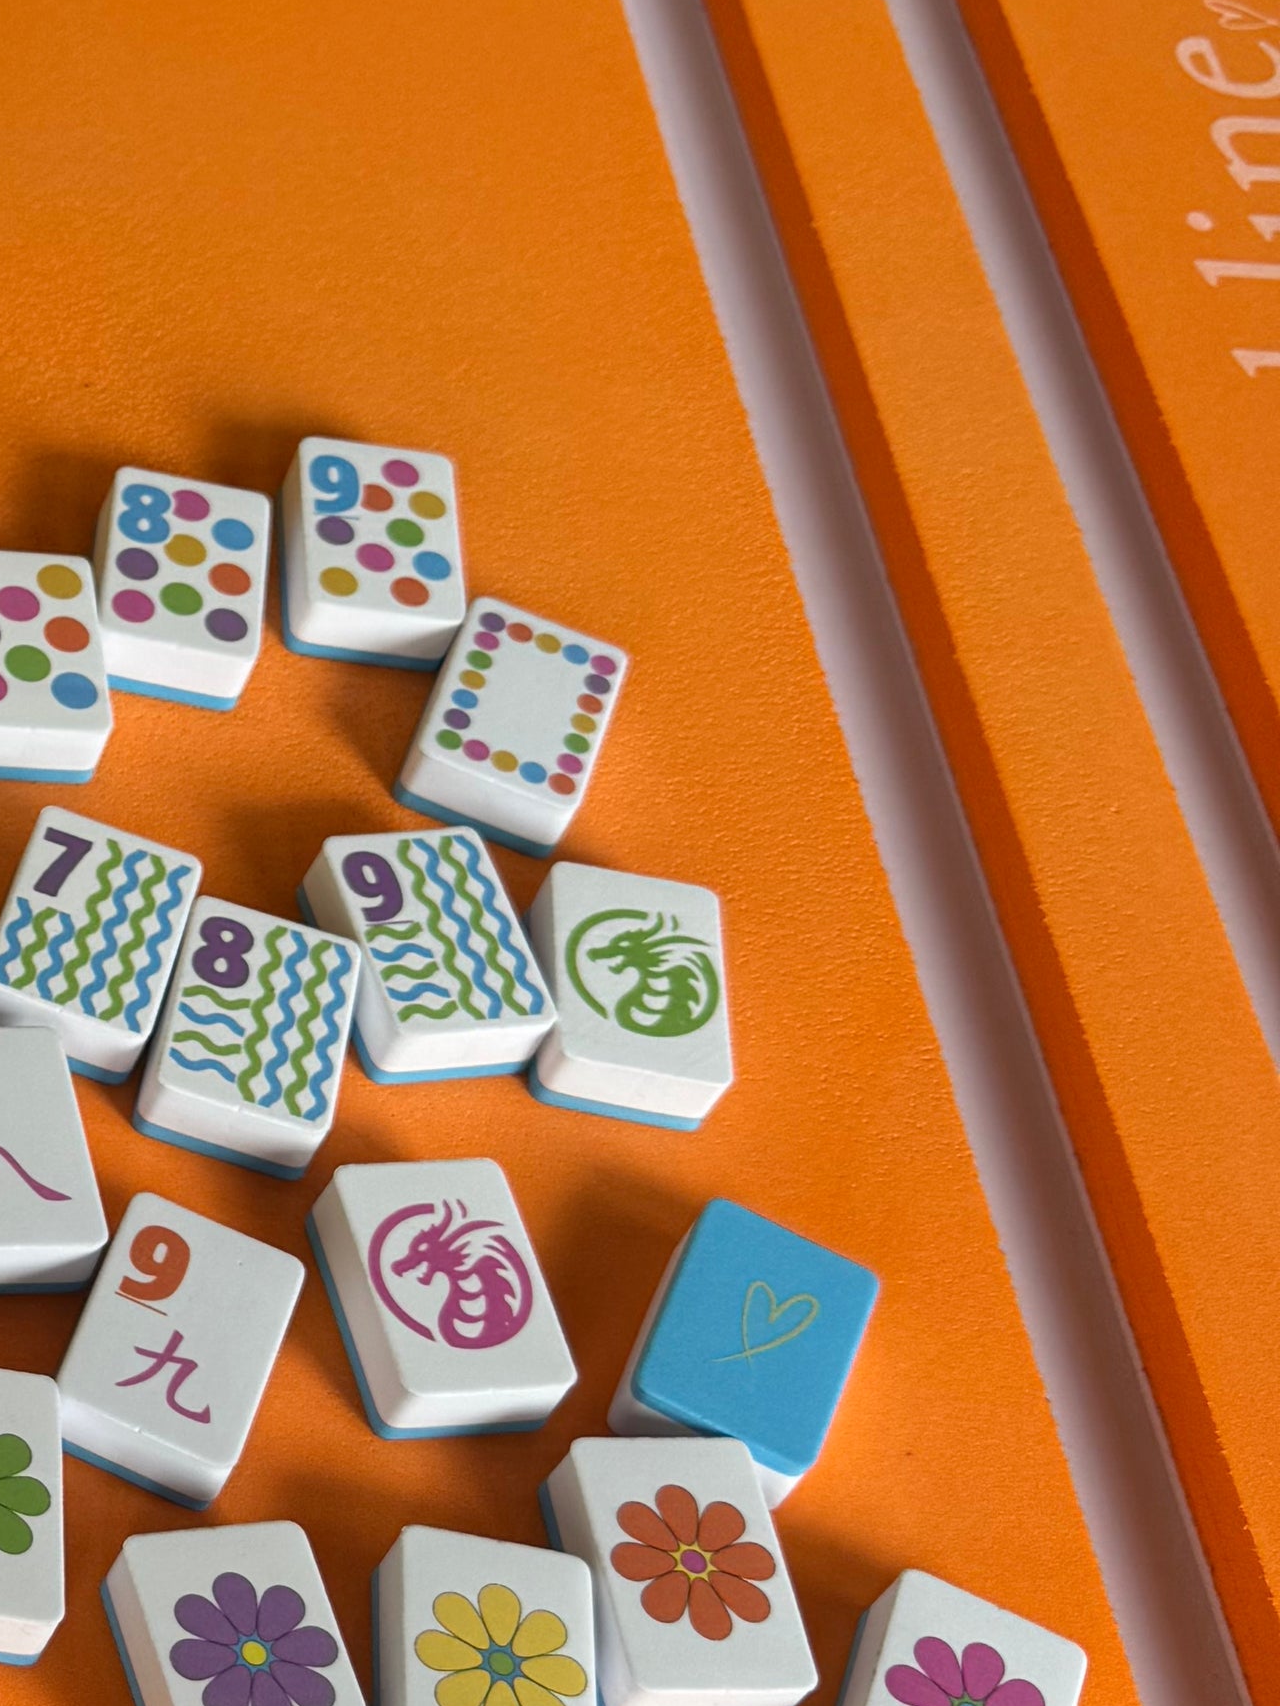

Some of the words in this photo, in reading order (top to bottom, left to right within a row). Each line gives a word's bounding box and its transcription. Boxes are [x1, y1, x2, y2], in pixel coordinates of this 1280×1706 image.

[119, 485, 171, 544] 8
[310, 456, 360, 513] 9
[33, 827, 93, 896] 7
[342, 852, 404, 922] 9
[193, 917, 254, 988] 8
[128, 1226, 191, 1302] 9
[115, 1329, 211, 1424] 九
